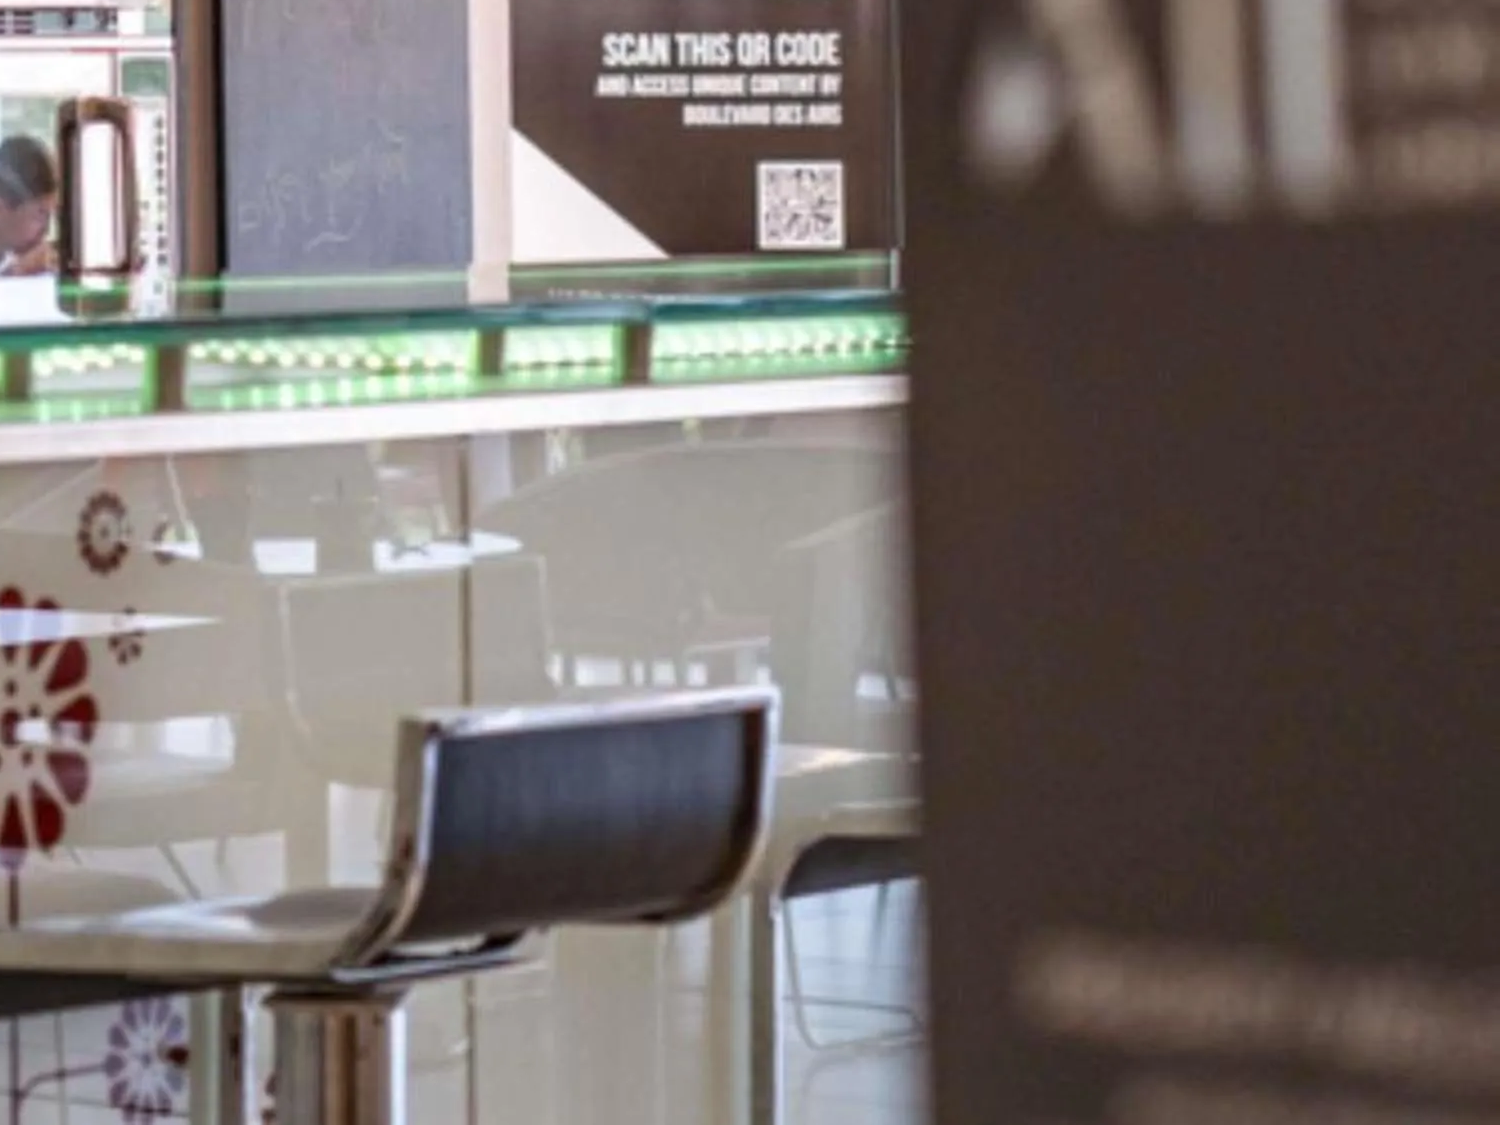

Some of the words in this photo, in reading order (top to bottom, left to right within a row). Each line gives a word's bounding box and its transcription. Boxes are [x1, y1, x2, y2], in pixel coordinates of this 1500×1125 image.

[602, 32, 672, 66] SCAN
[674, 32, 731, 66] THIS
[736, 32, 771, 66] QR
[776, 32, 842, 66] CODE
[750, 74, 816, 96] CONTENT
[683, 104, 771, 125] BOULEVARD
